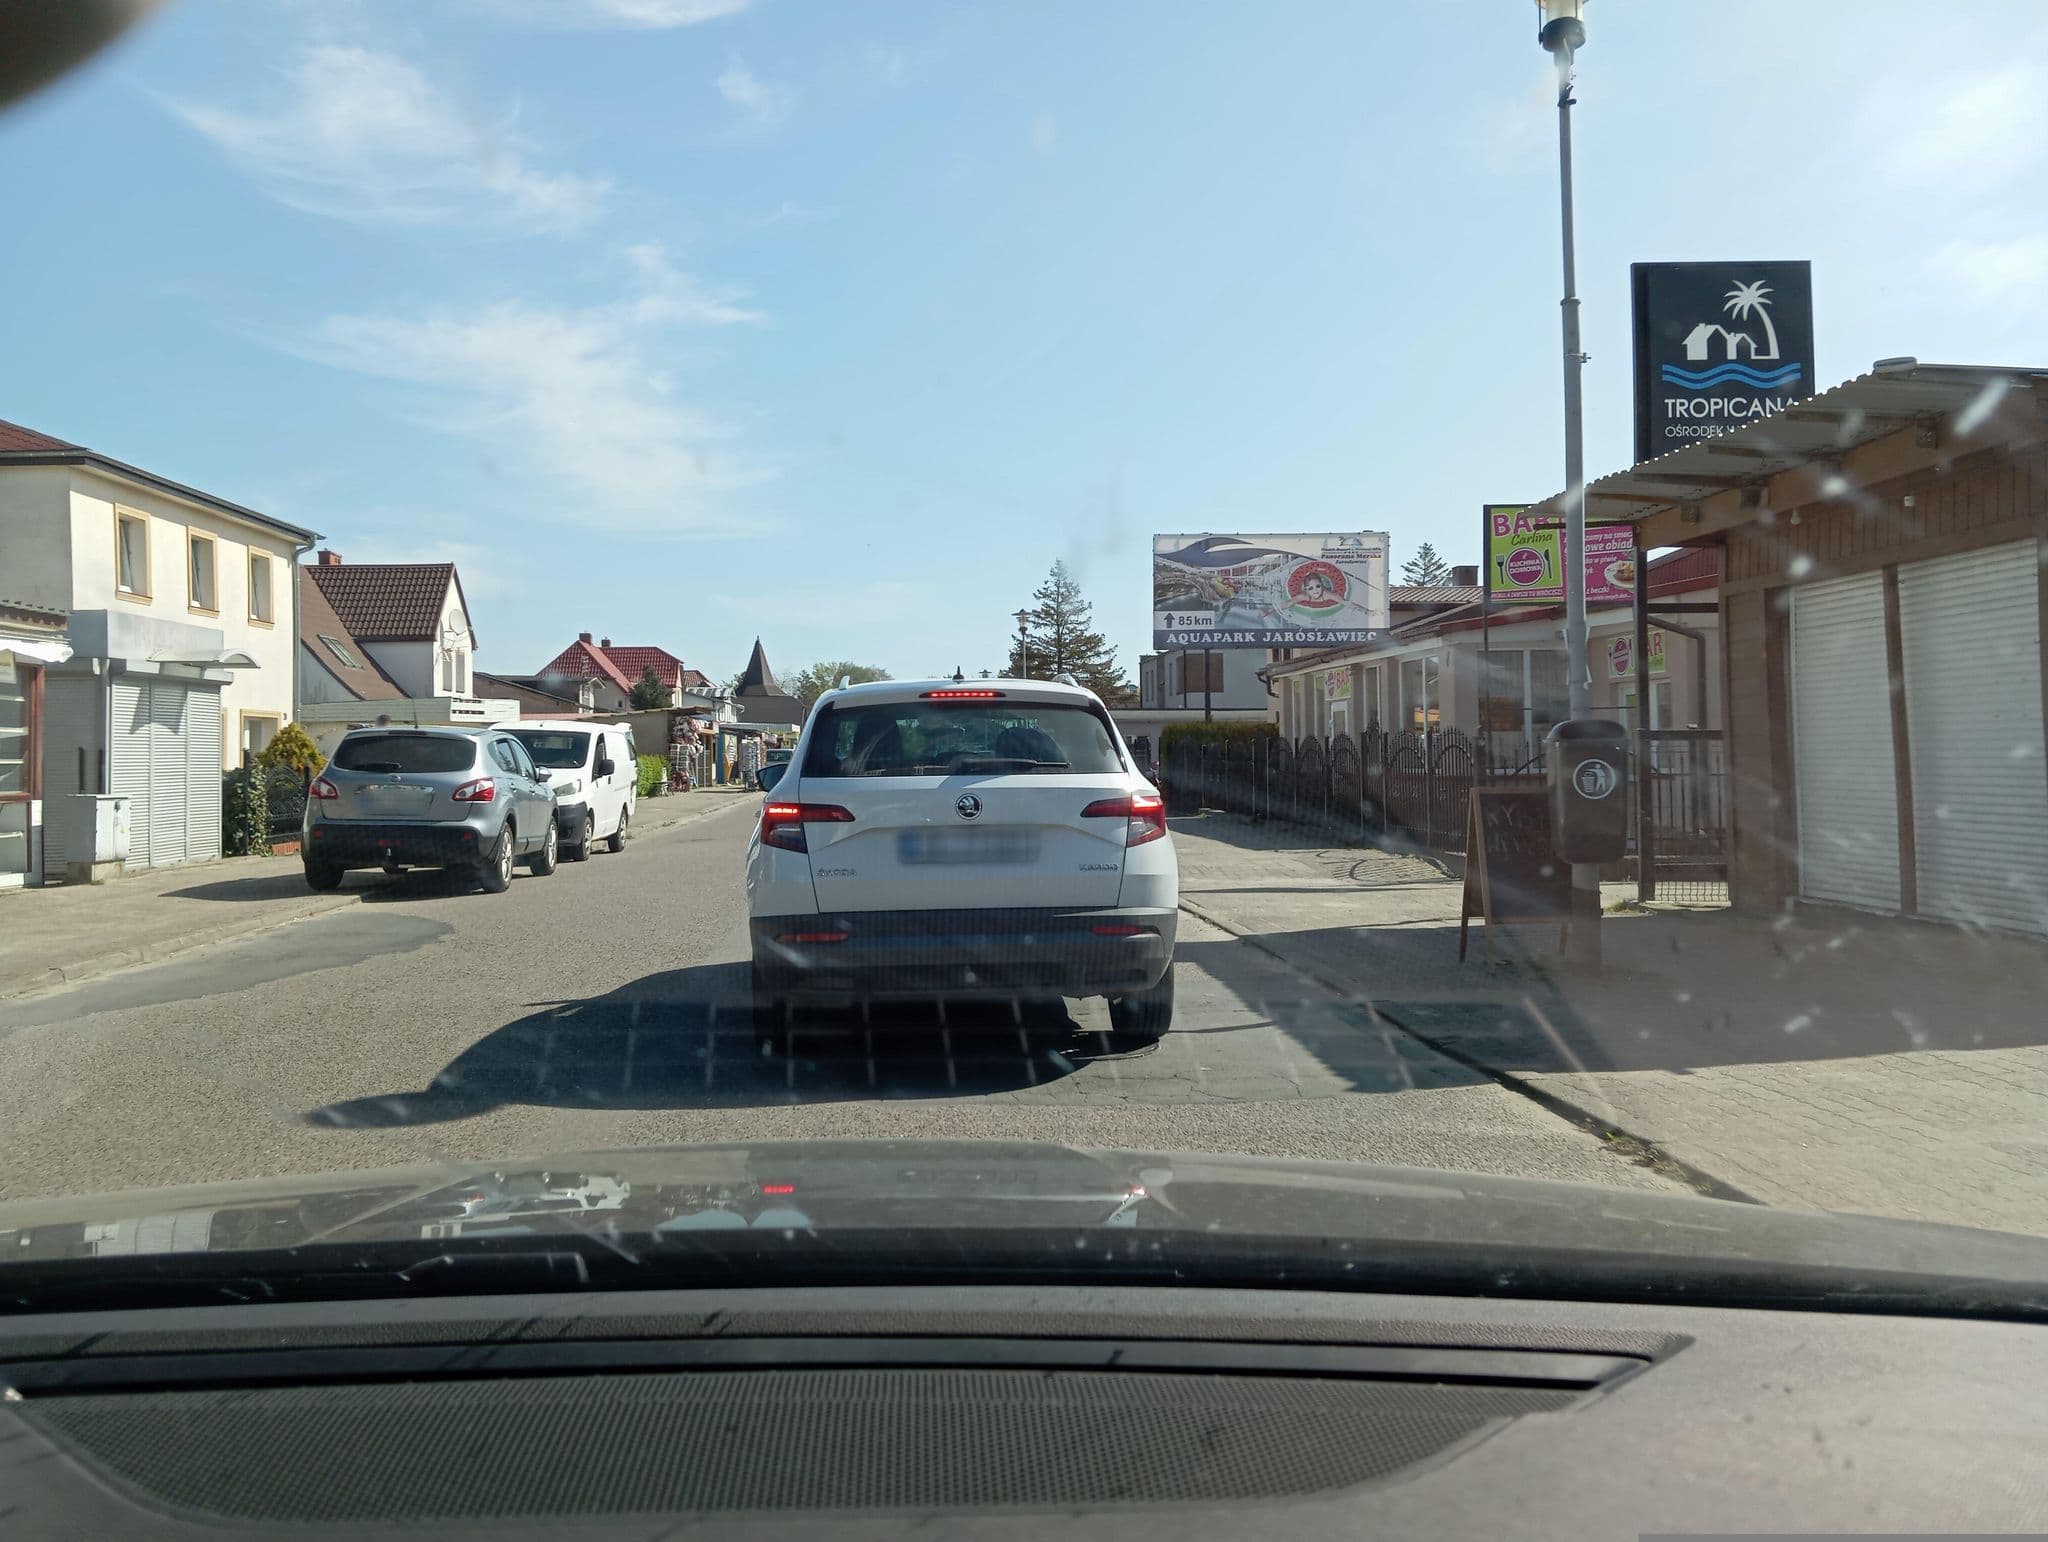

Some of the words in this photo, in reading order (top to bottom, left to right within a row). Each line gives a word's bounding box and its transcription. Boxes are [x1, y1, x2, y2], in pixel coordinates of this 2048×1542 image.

[1492, 512, 1548, 537] BA
[1511, 532, 1552, 546] Carlina
[1605, 538, 1632, 550] obiad
[1178, 615, 1193, 626] 85
[1194, 615, 1212, 626] km
[1166, 632, 1256, 645] AQUAPARK
